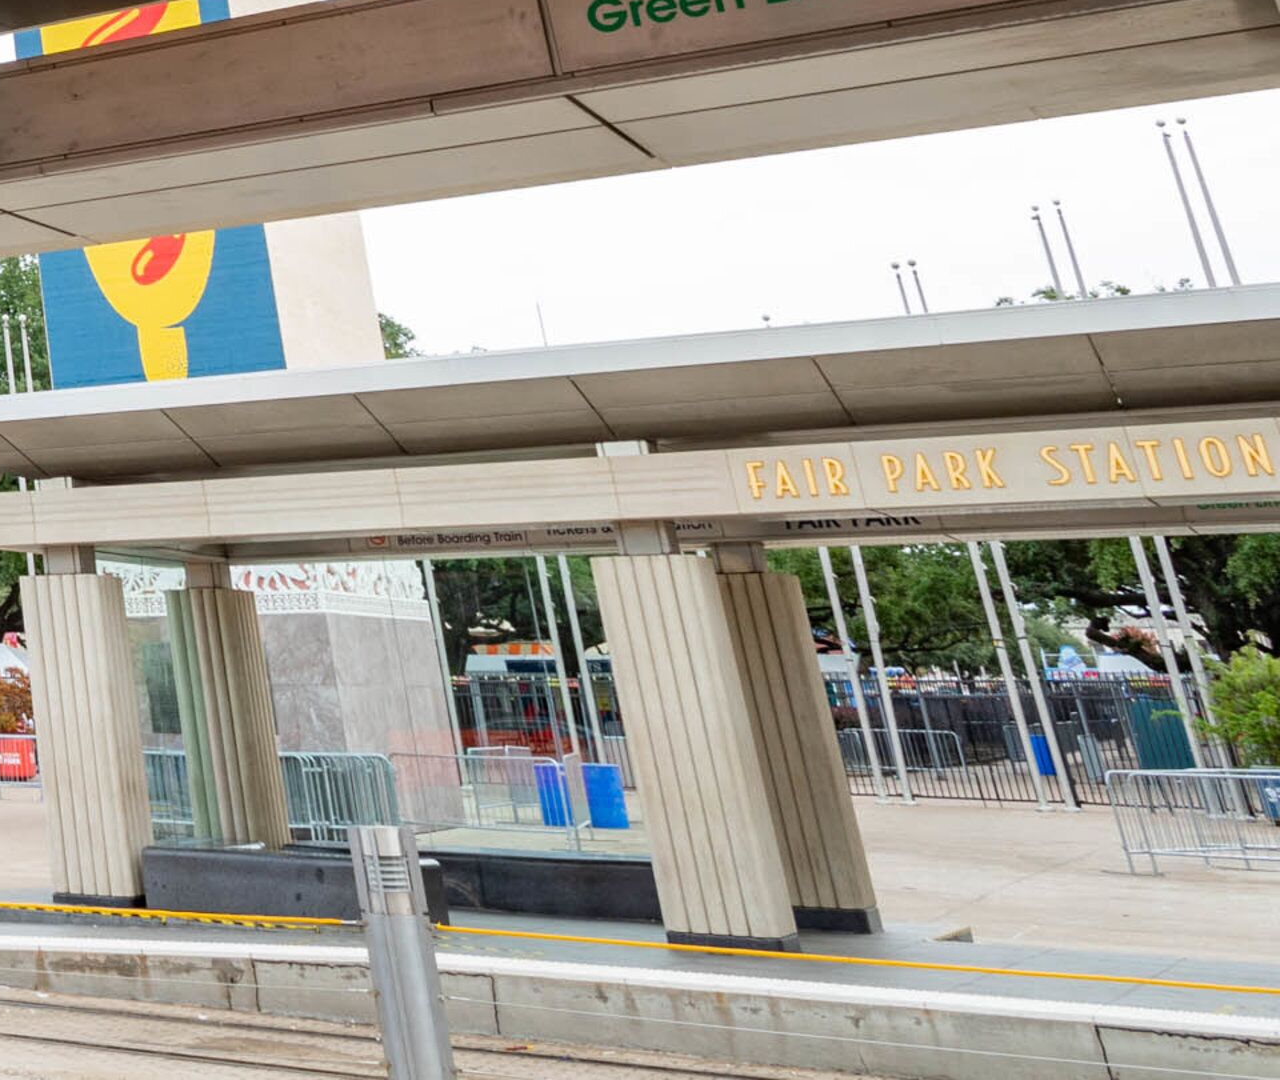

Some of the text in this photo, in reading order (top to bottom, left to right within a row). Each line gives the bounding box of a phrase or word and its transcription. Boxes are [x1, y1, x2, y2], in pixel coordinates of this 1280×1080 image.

[746, 433, 1275, 499] FAIR PARK STATION
[397, 531, 523, 546] Before Boarding Train
